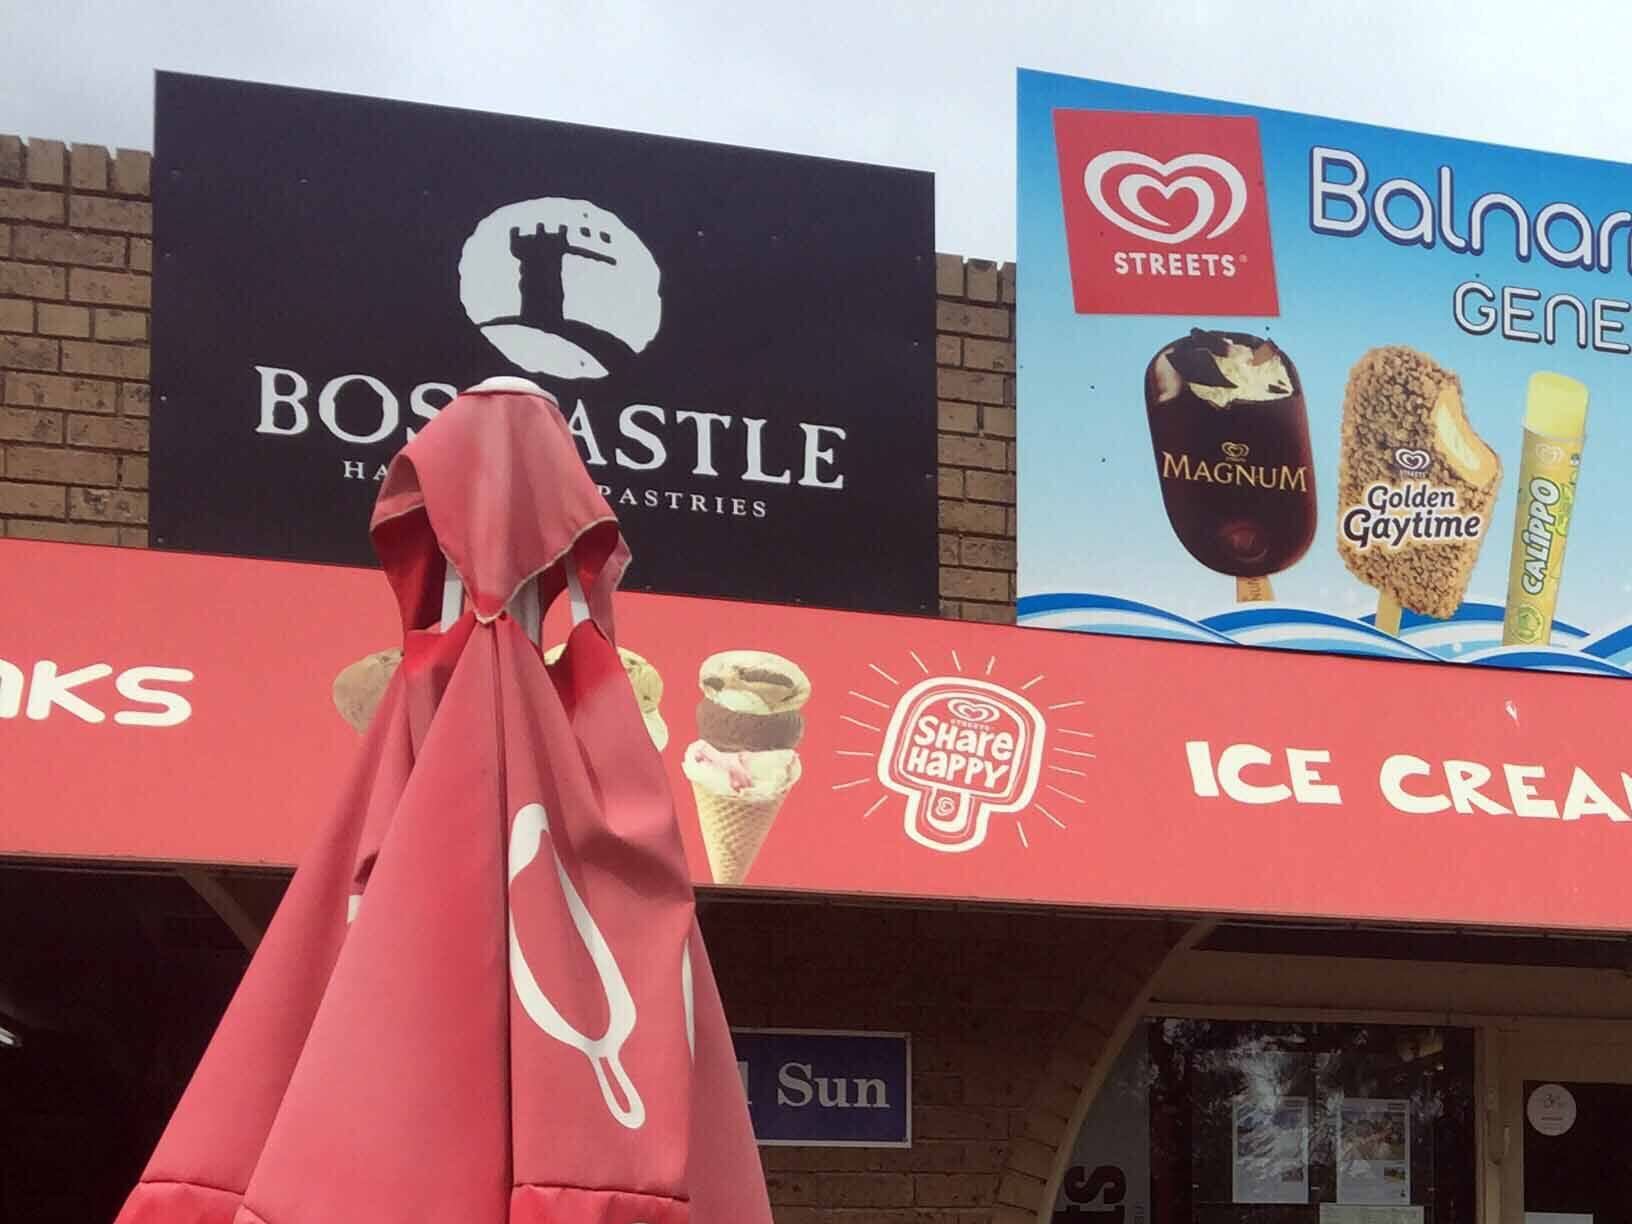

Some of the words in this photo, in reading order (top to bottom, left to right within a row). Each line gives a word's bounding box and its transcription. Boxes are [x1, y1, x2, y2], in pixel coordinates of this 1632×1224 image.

[1113, 251, 1237, 277] STREETS
[254, 364, 847, 490] BOSASTLE
[1162, 452, 1308, 493] MAGNUM
[599, 484, 768, 518] PASTRIES
[1367, 483, 1456, 516] Golden
[1343, 508, 1482, 547] Gaytime
[1185, 740, 1343, 805] ICE
[777, 1062, 891, 1109] Sun
